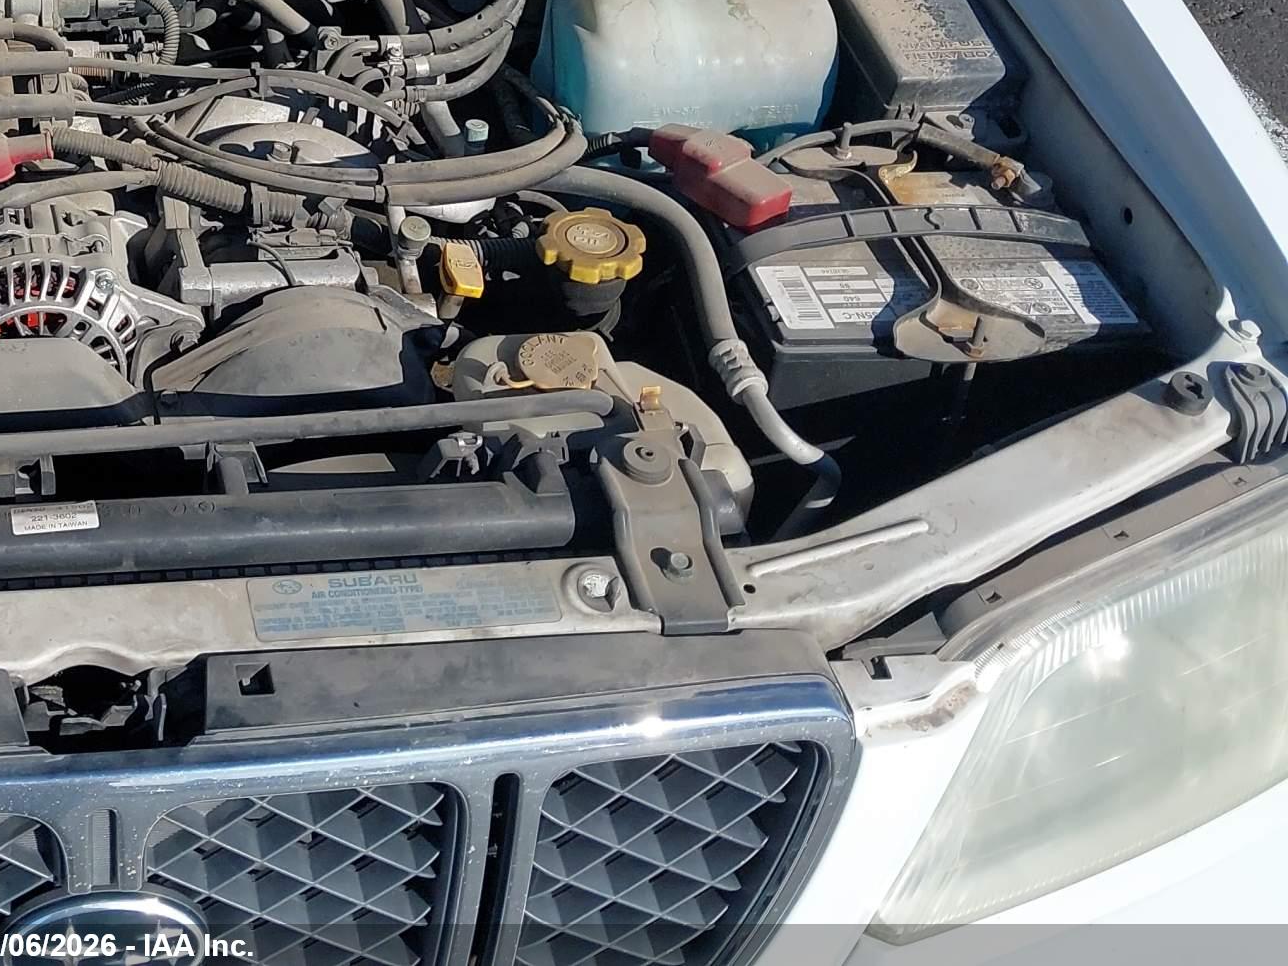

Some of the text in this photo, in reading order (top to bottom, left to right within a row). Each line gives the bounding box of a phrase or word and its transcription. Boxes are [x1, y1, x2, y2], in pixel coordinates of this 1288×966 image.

[519, 334, 565, 367] COOLANT
[24, 523, 47, 531] MADE
[58, 520, 88, 529] TAIWAN
[328, 573, 418, 588] SUBARU
